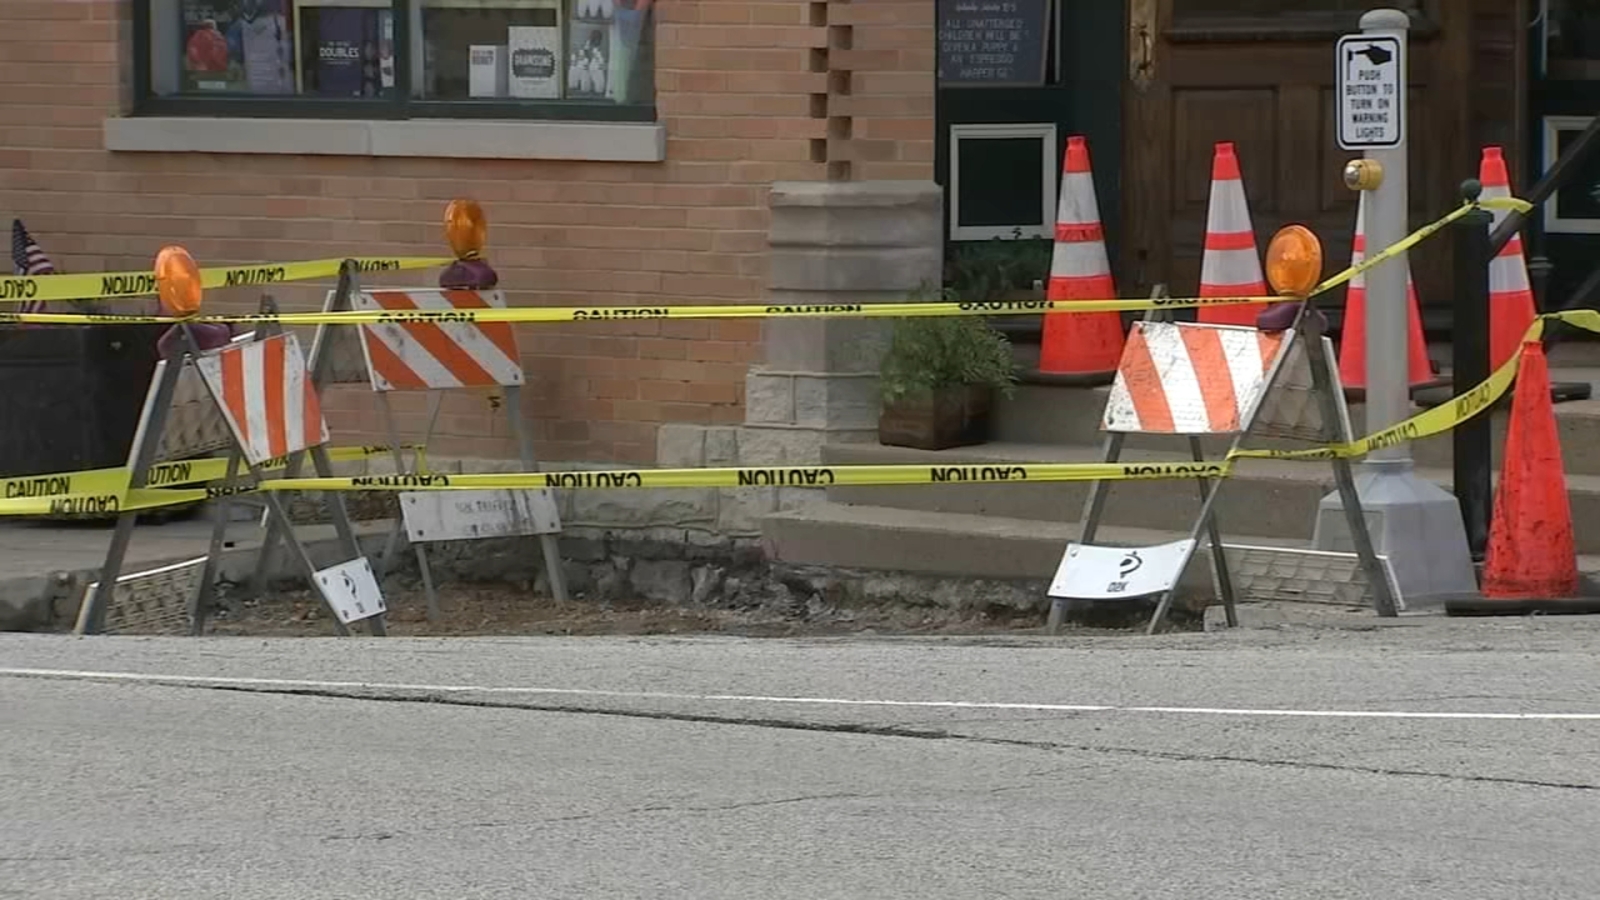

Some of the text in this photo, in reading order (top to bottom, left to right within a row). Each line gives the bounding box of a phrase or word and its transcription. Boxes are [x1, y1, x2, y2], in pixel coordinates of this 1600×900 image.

[319, 47, 360, 58] DOUBLES
[1359, 69, 1381, 81] PUSH
[1346, 83, 1394, 96] BUTTON TO
[1351, 98, 1390, 110] TURN ON
[1352, 112, 1388, 124] WARNING
[1355, 126, 1385, 139] LIGHTS
[224, 267, 285, 287] CAUTION
[101, 275, 158, 295] AUTION
[545, 472, 641, 488] CAUTION
[738, 469, 834, 486] CAUTION
[930, 467, 1027, 482] CAUTION
[6, 477, 70, 499] CAUTION
